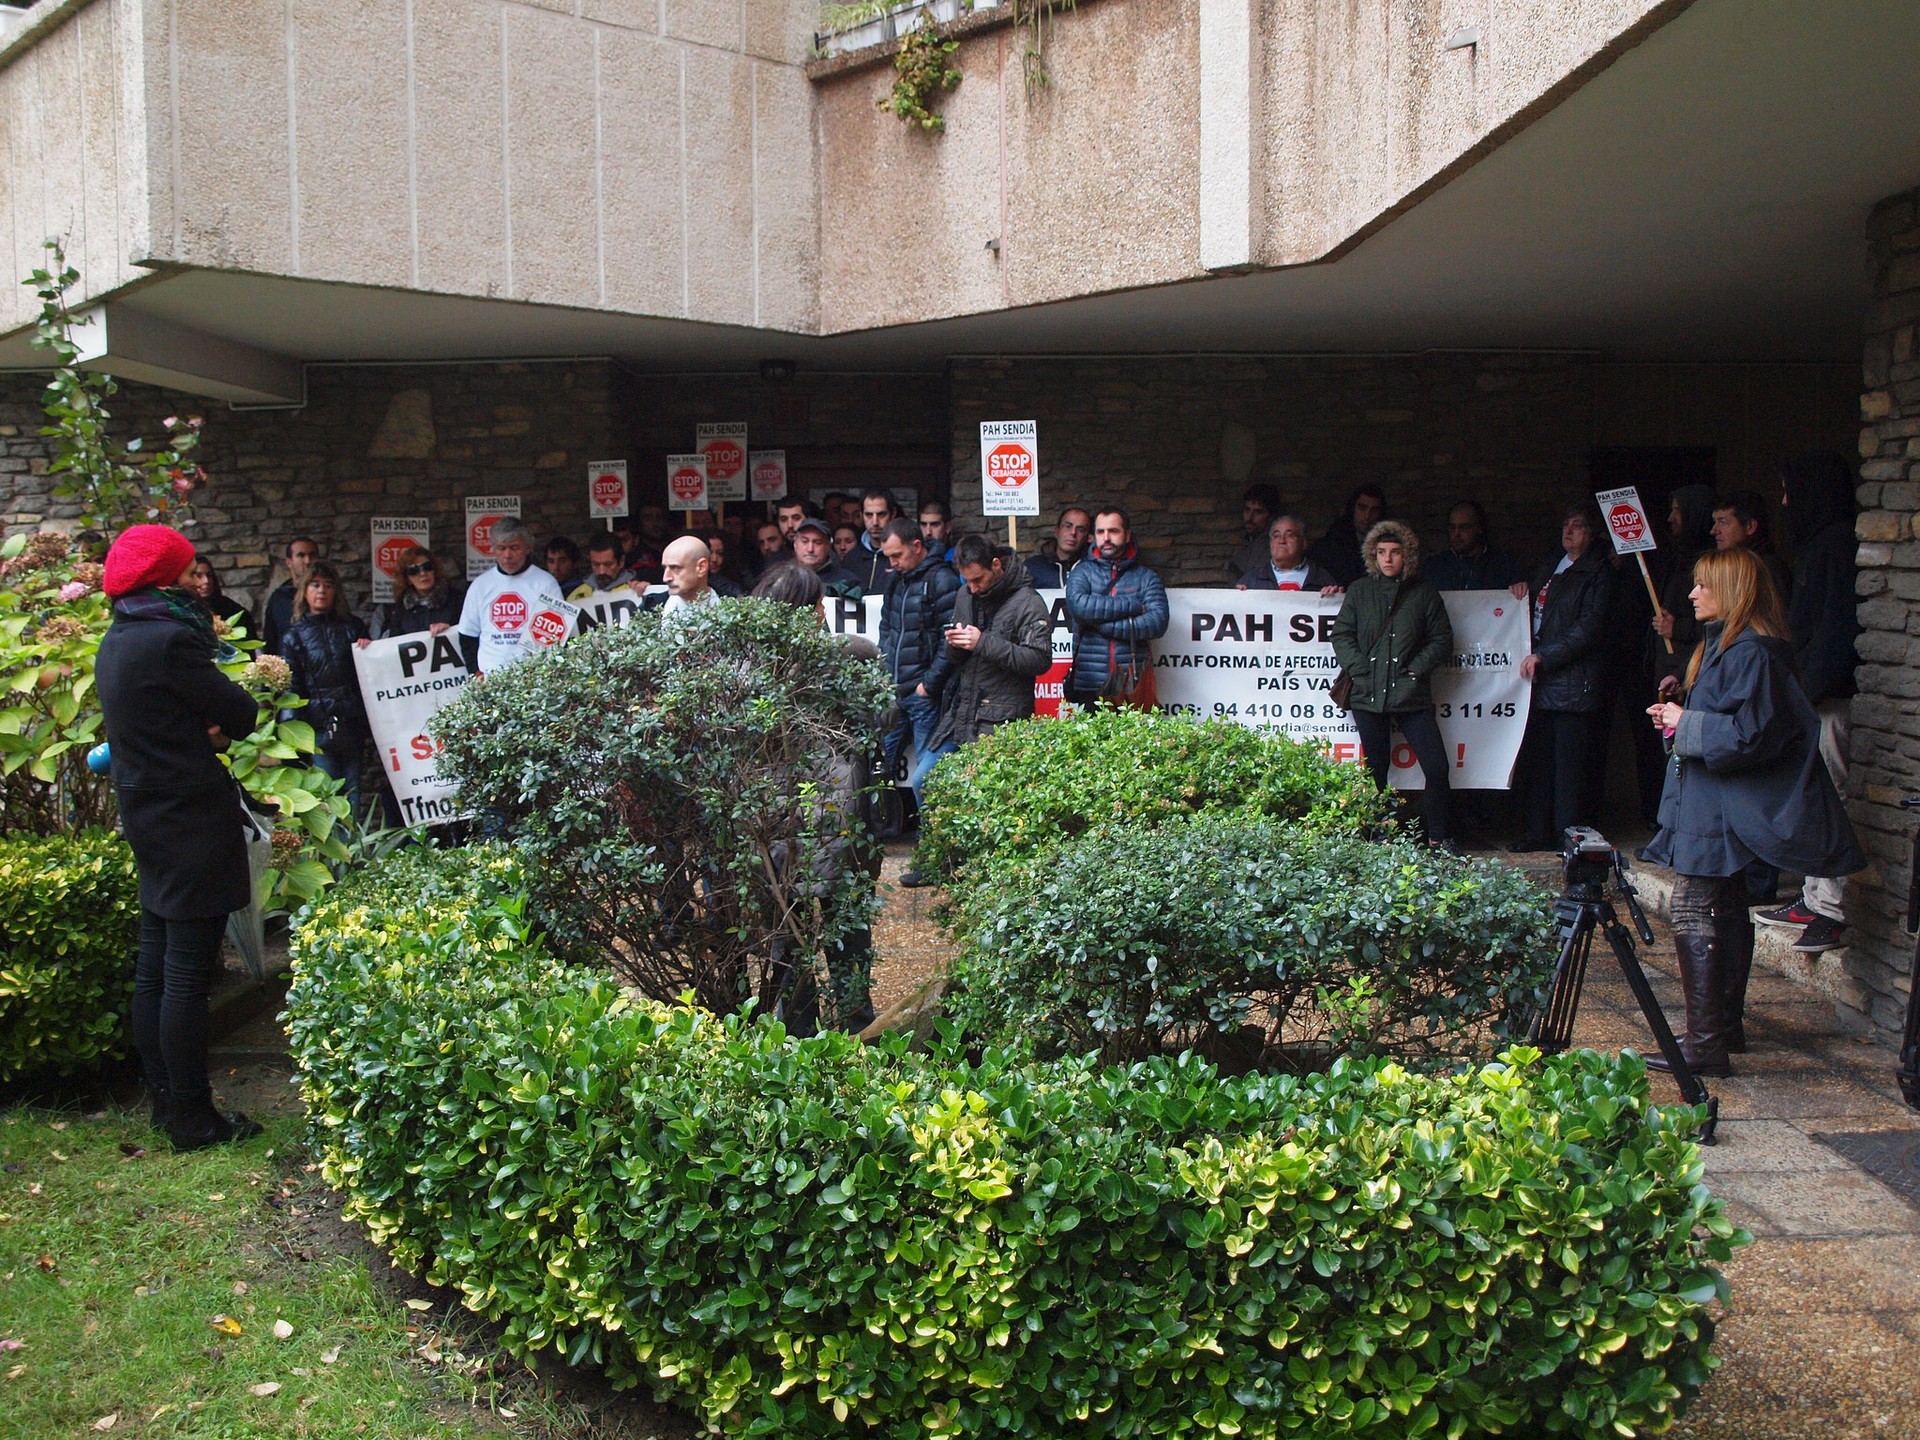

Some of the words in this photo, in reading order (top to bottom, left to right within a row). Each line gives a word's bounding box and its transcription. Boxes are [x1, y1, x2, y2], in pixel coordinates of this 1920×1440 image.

[698, 425, 714, 435] PAH
[716, 424, 746, 434] SENDIA
[983, 424, 1000, 435] PAH
[1003, 423, 1035, 435] SENDIA
[705, 450, 740, 463] STOP
[990, 454, 1030, 469] STOP
[756, 469, 781, 479] STOP
[991, 469, 1030, 477] DESAHUCIOS
[595, 482, 621, 494] STOP
[674, 476, 701, 487] STOP
[1598, 493, 1611, 501] PAH
[1612, 488, 1636, 499] SENDIA
[467, 499, 485, 510] PAH
[487, 497, 519, 509] SENDIA
[373, 520, 392, 531] PAH
[394, 520, 428, 531] SENDIA
[1611, 511, 1639, 527] STOP
[493, 602, 525, 615] STOP
[540, 594, 553, 602] PAH
[554, 600, 578, 615] SENDIA
[535, 616, 564, 635] STOP
[1191, 613, 1273, 642] PAH
[398, 635, 465, 678] PA
[1153, 654, 1261, 669] ATAFORMA
[1265, 655, 1281, 668] DE
[1257, 670, 1300, 690] PAÍS
[1213, 702, 1238, 717] 94
[1245, 703, 1283, 718] 410
[1290, 704, 1315, 719] 08
[1322, 704, 1347, 719] 83
[1440, 703, 1452, 718] 3
[1460, 703, 1483, 718] 11
[1490, 702, 1516, 718] 45
